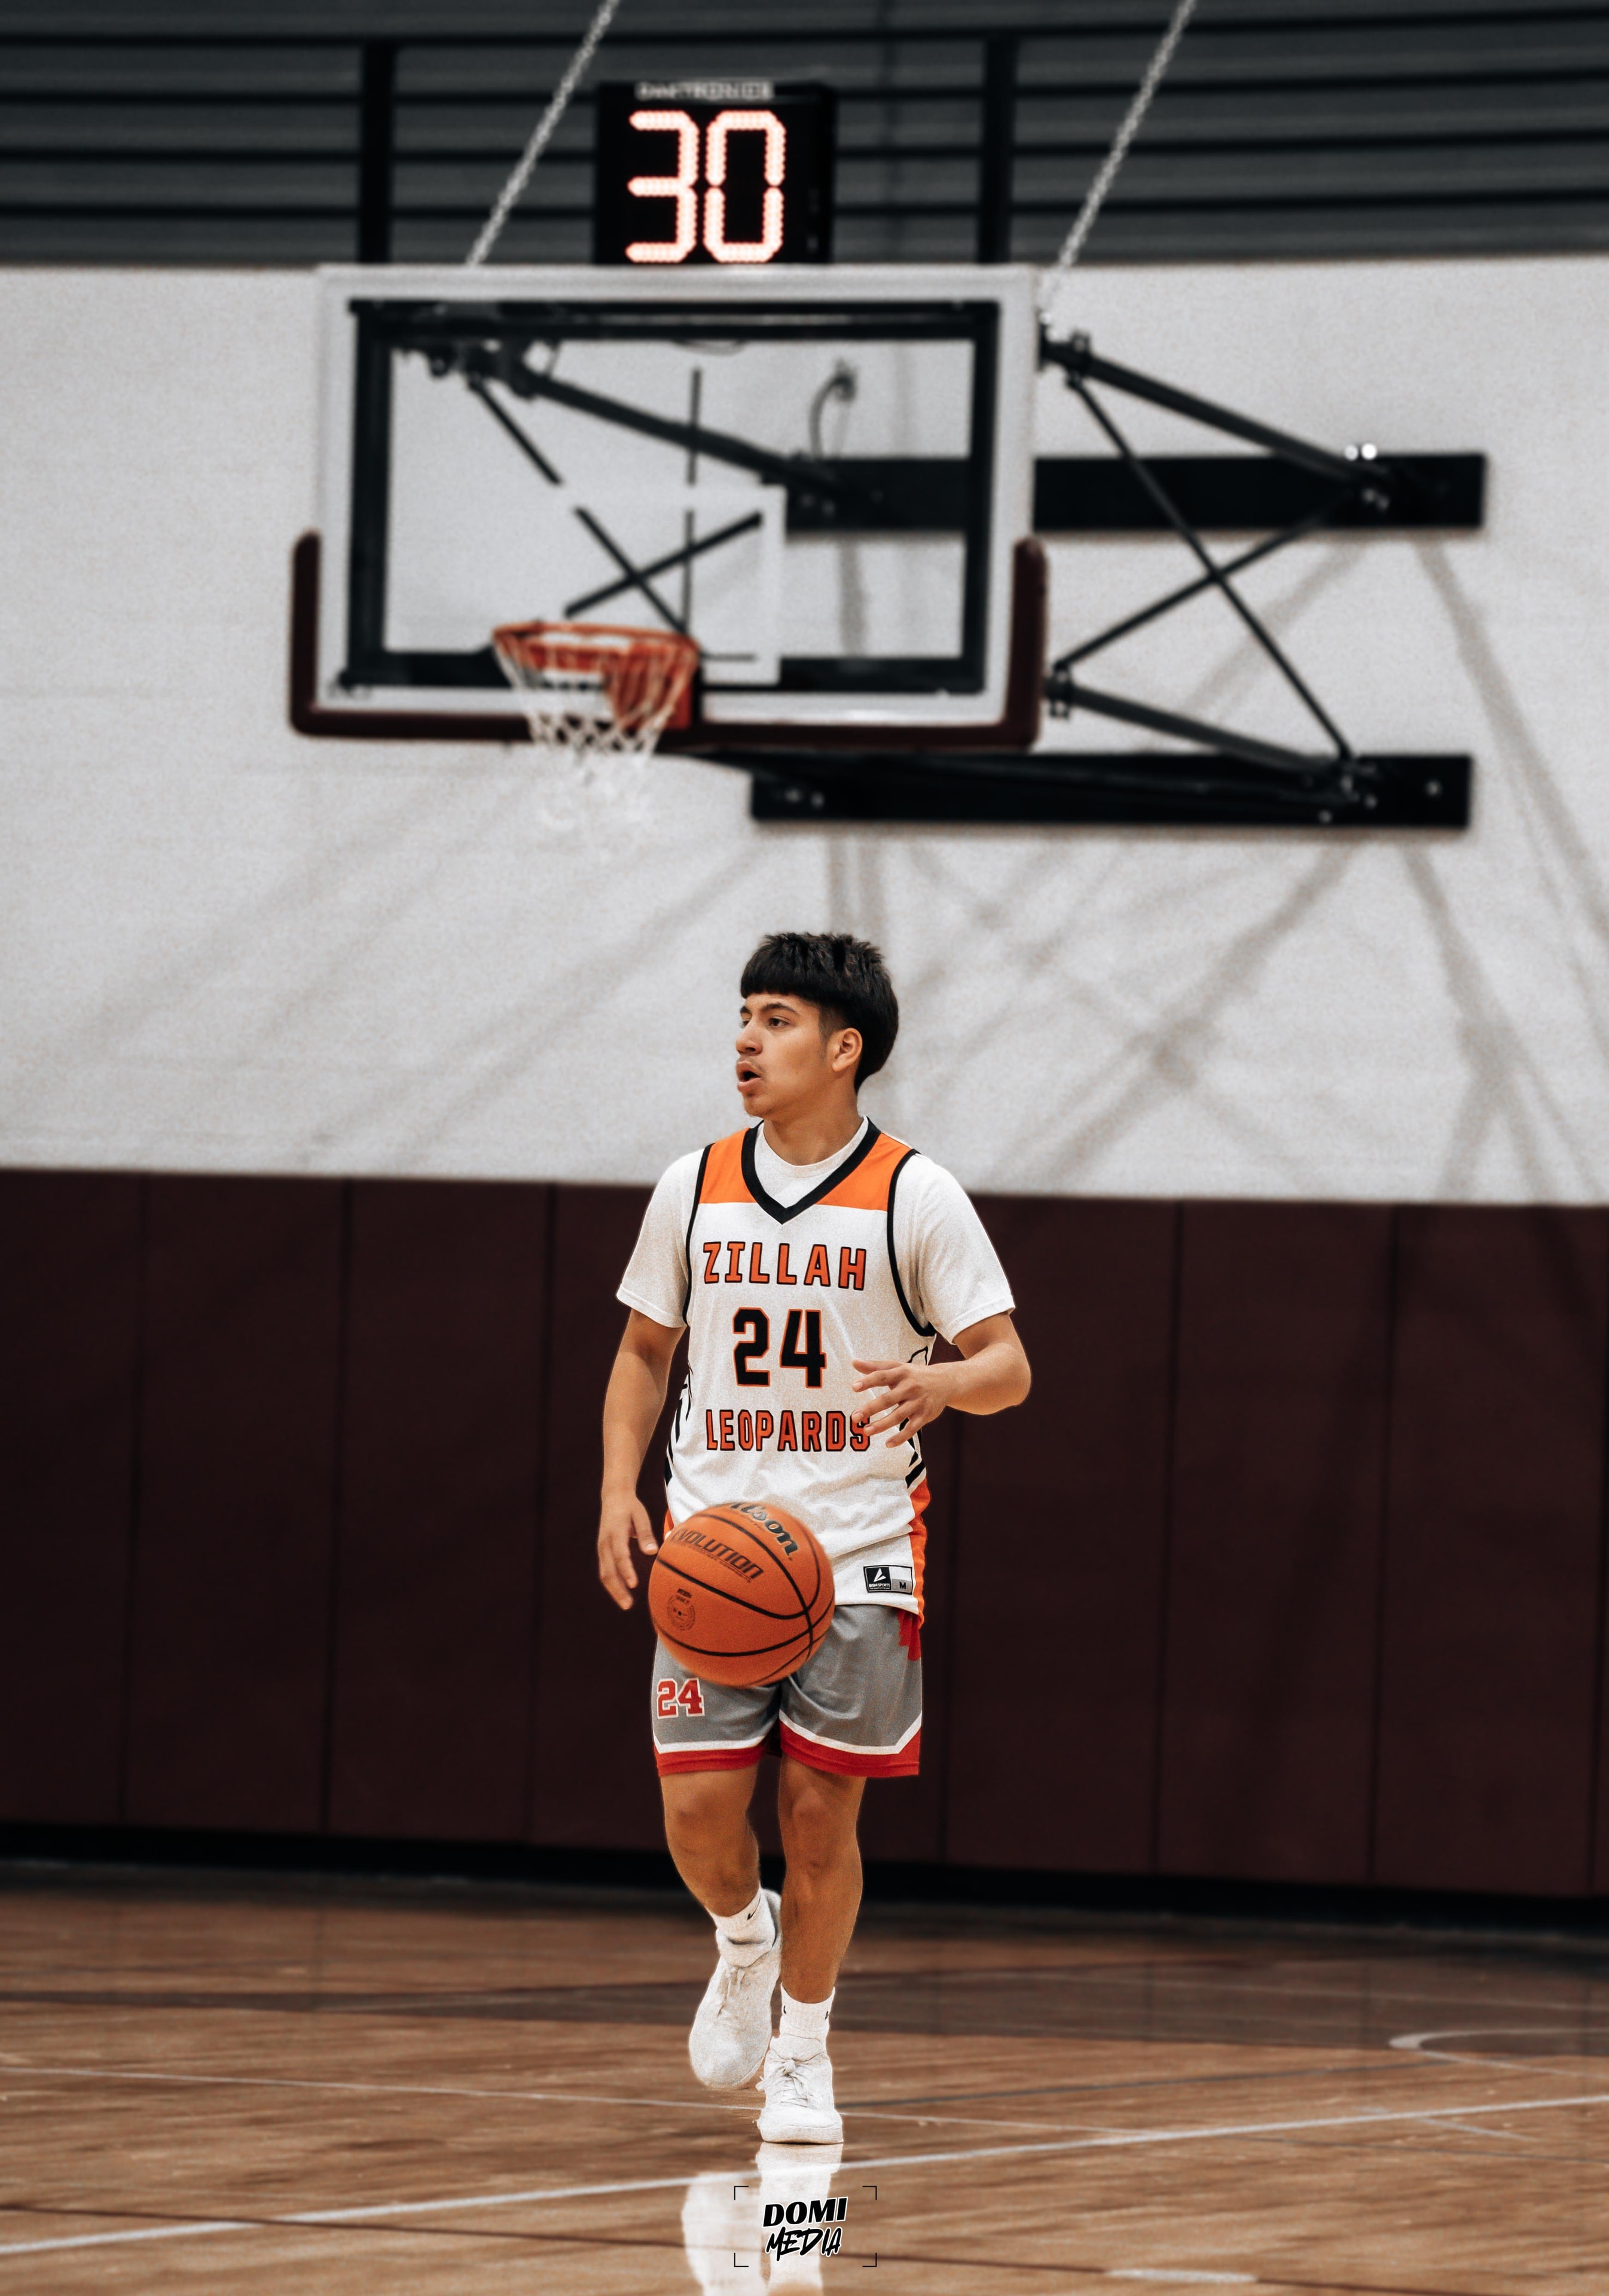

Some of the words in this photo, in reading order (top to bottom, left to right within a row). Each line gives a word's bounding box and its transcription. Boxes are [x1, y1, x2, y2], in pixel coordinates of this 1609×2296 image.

[625, 109, 786, 263] 30
[703, 1241, 866, 1291] ZILLAH
[732, 1307, 827, 1388] 24
[706, 1409, 871, 1452] LEOPARDS
[671, 1528, 764, 1579] VOLUTION
[729, 1501, 799, 1557] ilson
[657, 1678, 705, 1719] 24
